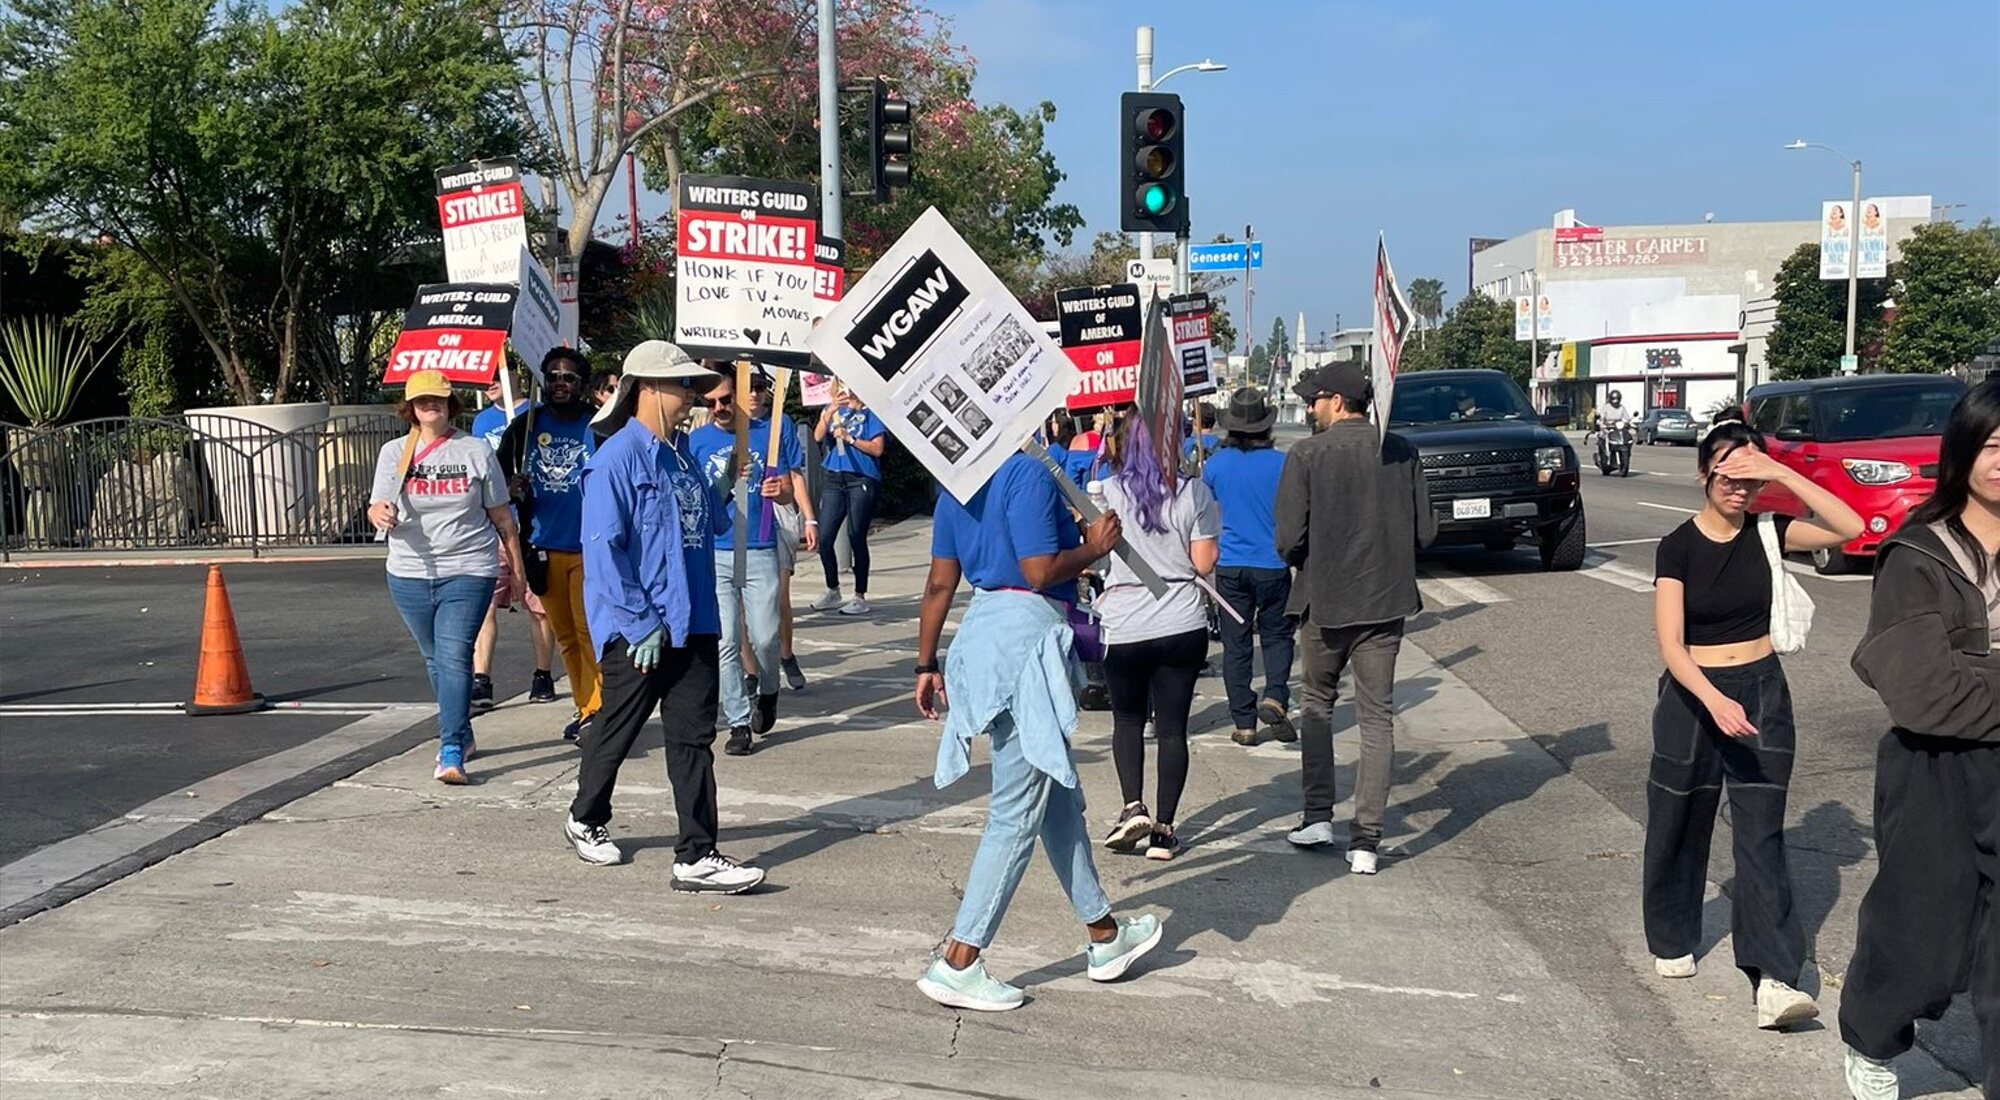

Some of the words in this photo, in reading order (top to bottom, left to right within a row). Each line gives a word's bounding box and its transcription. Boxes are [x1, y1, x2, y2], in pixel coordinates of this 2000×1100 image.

[441, 171, 482, 189] WRITERS
[484, 166, 513, 183] GUILD
[445, 188, 517, 224] STRIKE!
[688, 186, 760, 208] WRITERS
[762, 192, 808, 211] GUILD
[740, 209, 756, 221] ON
[687, 219, 806, 260] STRIKE!
[1558, 240, 1628, 256] LESTER
[1636, 237, 1706, 254] CARPET
[814, 243, 839, 260] UILD
[1191, 252, 1239, 263] Genesee
[685, 260, 738, 280] HONK
[748, 269, 765, 283] IF
[774, 271, 808, 291] YOU
[420, 291, 473, 304] WRITERS
[474, 292, 511, 303] GUILD
[686, 286, 730, 302] LOVE
[741, 287, 767, 302] TV
[452, 303, 468, 312] OF
[1062, 298, 1106, 313] WRITERS
[1107, 295, 1135, 308] GUILD
[427, 315, 483, 326] AMERICA
[762, 306, 809, 321] MOVIES
[862, 266, 949, 360] WGAW
[1095, 313, 1106, 323] OF
[681, 326, 740, 340] WRITERS
[767, 331, 791, 346] LA
[1081, 325, 1123, 340] AMERICA
[1175, 317, 1208, 341] STRIKE!
[437, 334, 461, 346] ON
[393, 349, 492, 371] STRIKE!
[1096, 350, 1114, 366] ON
[408, 477, 469, 495] TRIKE!
